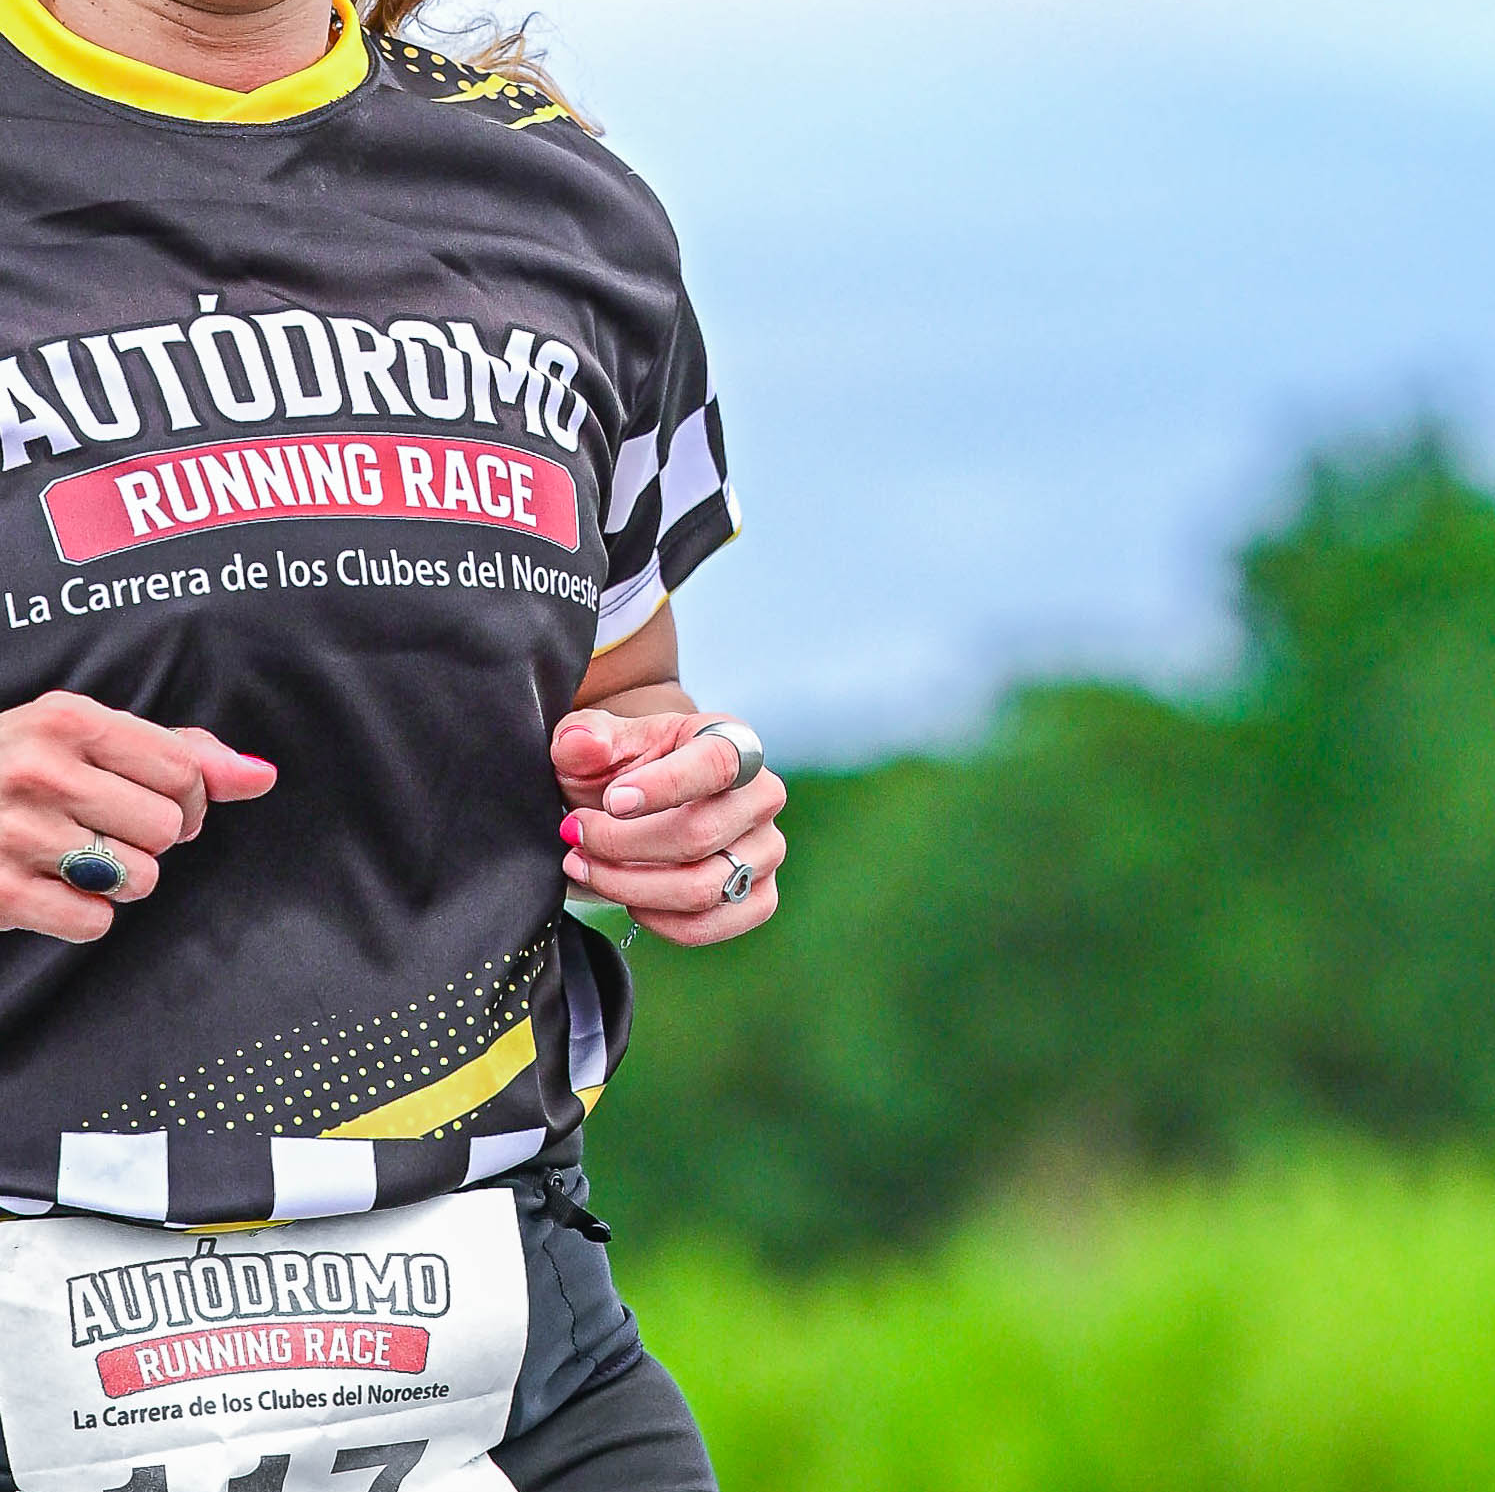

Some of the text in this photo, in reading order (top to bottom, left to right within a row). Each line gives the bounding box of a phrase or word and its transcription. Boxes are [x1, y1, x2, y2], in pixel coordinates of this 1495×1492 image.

[114, 442, 538, 537] RUNNING RACE
[5, 549, 599, 630] La Carrera de los Clubes del Noroeste
[66, 1237, 451, 1347] AUTÓDROMO
[134, 1327, 392, 1386] RUNNING RACE
[72, 1380, 450, 1431] La Carrera de los Clubes del Noroeste
